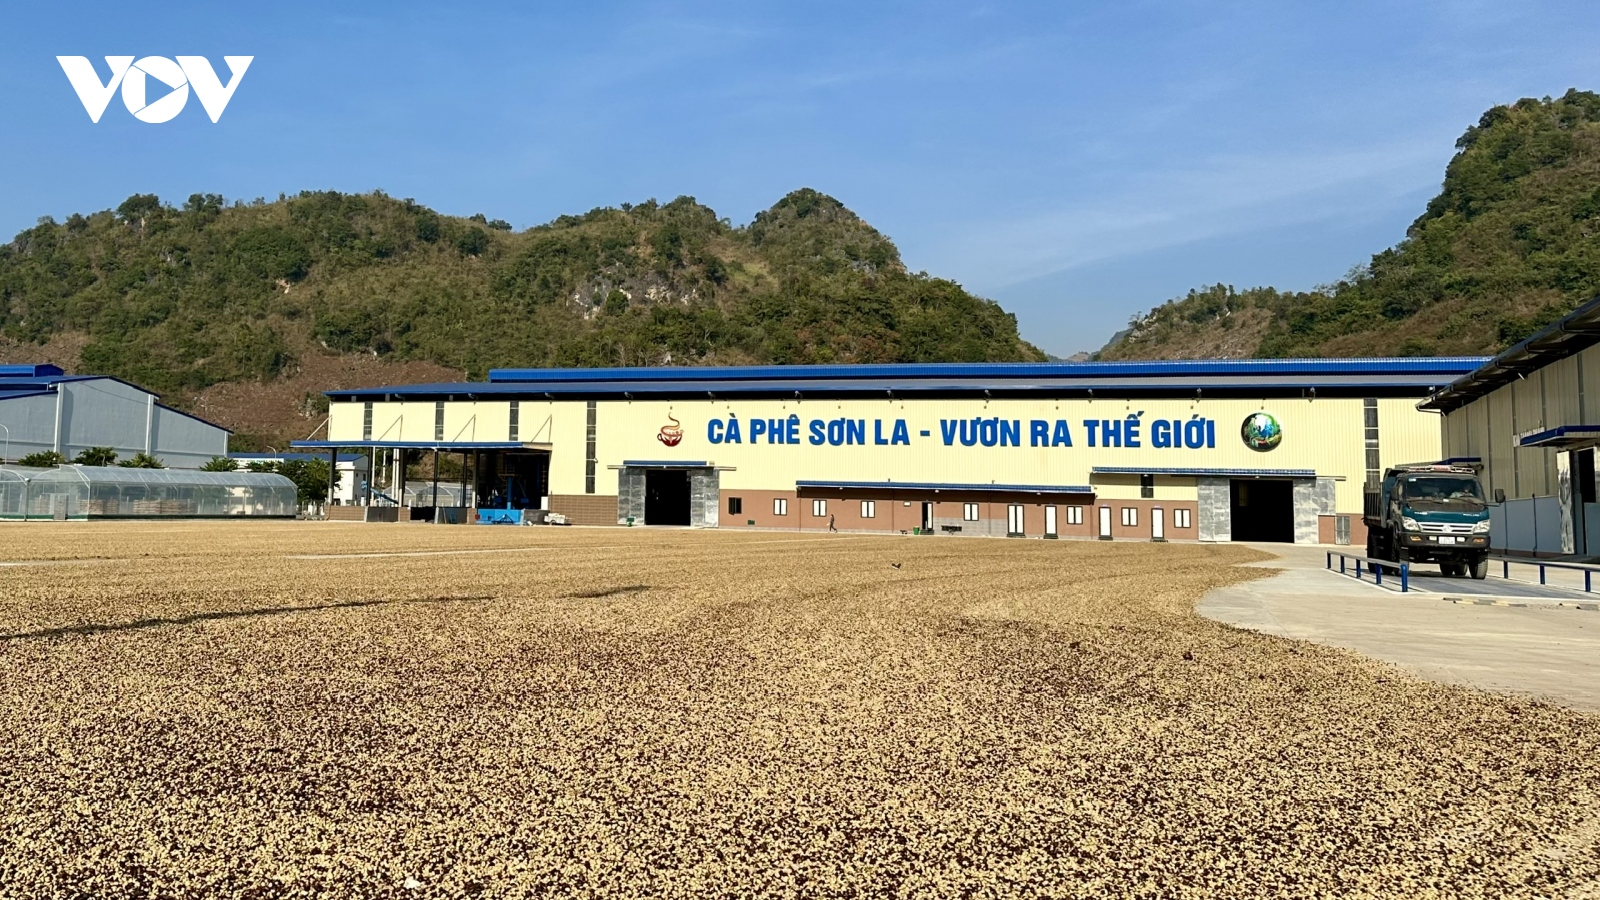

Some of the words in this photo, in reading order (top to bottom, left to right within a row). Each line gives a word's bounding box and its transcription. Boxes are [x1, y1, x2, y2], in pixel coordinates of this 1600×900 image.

[707, 413, 742, 444] CÀ
[750, 414, 800, 444] PHÊ
[808, 417, 866, 446] SƠN
[874, 419, 910, 445] LA
[940, 417, 1020, 447] VƯƠN
[1030, 420, 1073, 447] RA
[1083, 411, 1144, 447] THẾ
[1151, 414, 1216, 448] GIỚI
